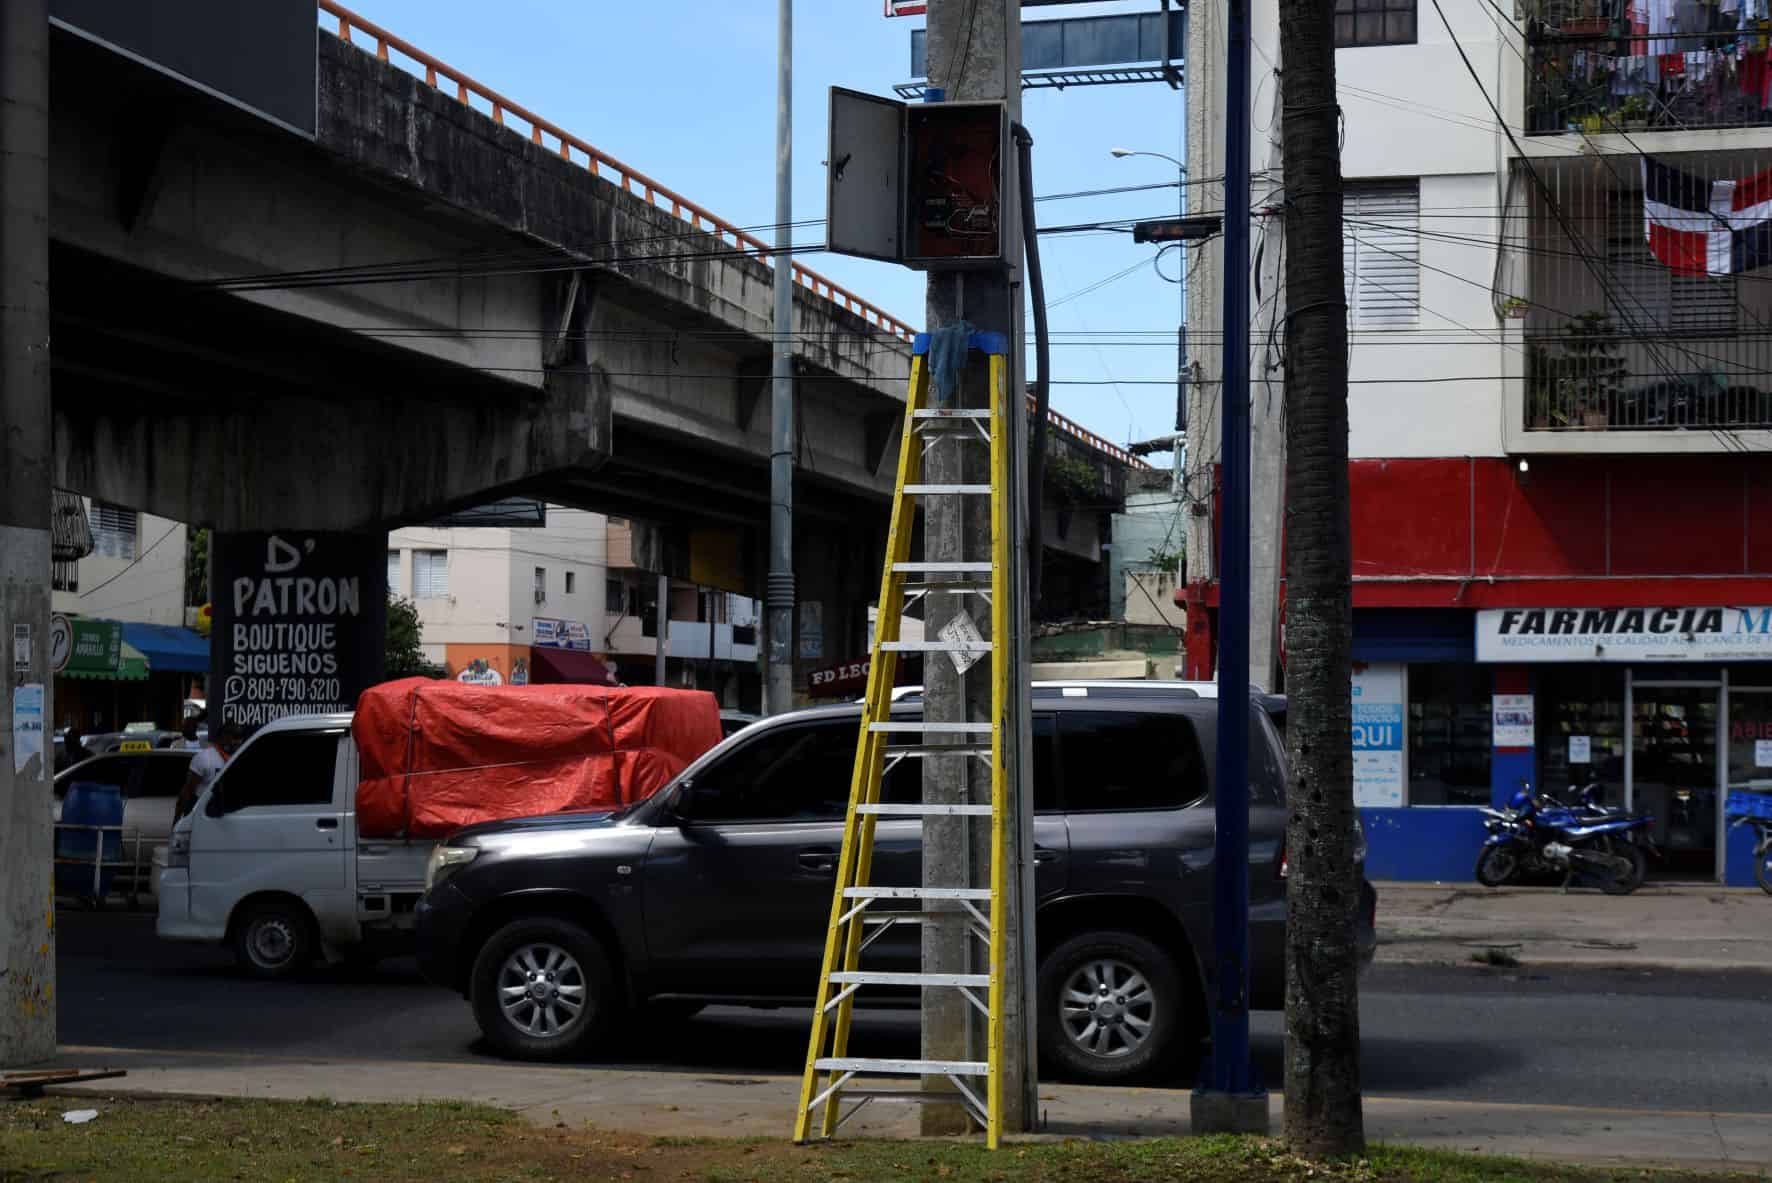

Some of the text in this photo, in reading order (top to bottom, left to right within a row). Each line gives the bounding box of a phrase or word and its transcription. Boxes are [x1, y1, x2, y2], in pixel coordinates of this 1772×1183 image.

[233, 575, 360, 617] PATRON
[1497, 608, 1723, 634] FARMACIA
[233, 623, 337, 652] BOUTIQUE
[1502, 636, 1594, 647] MEDICAMENTOS
[234, 653, 337, 674] SIGUENOS
